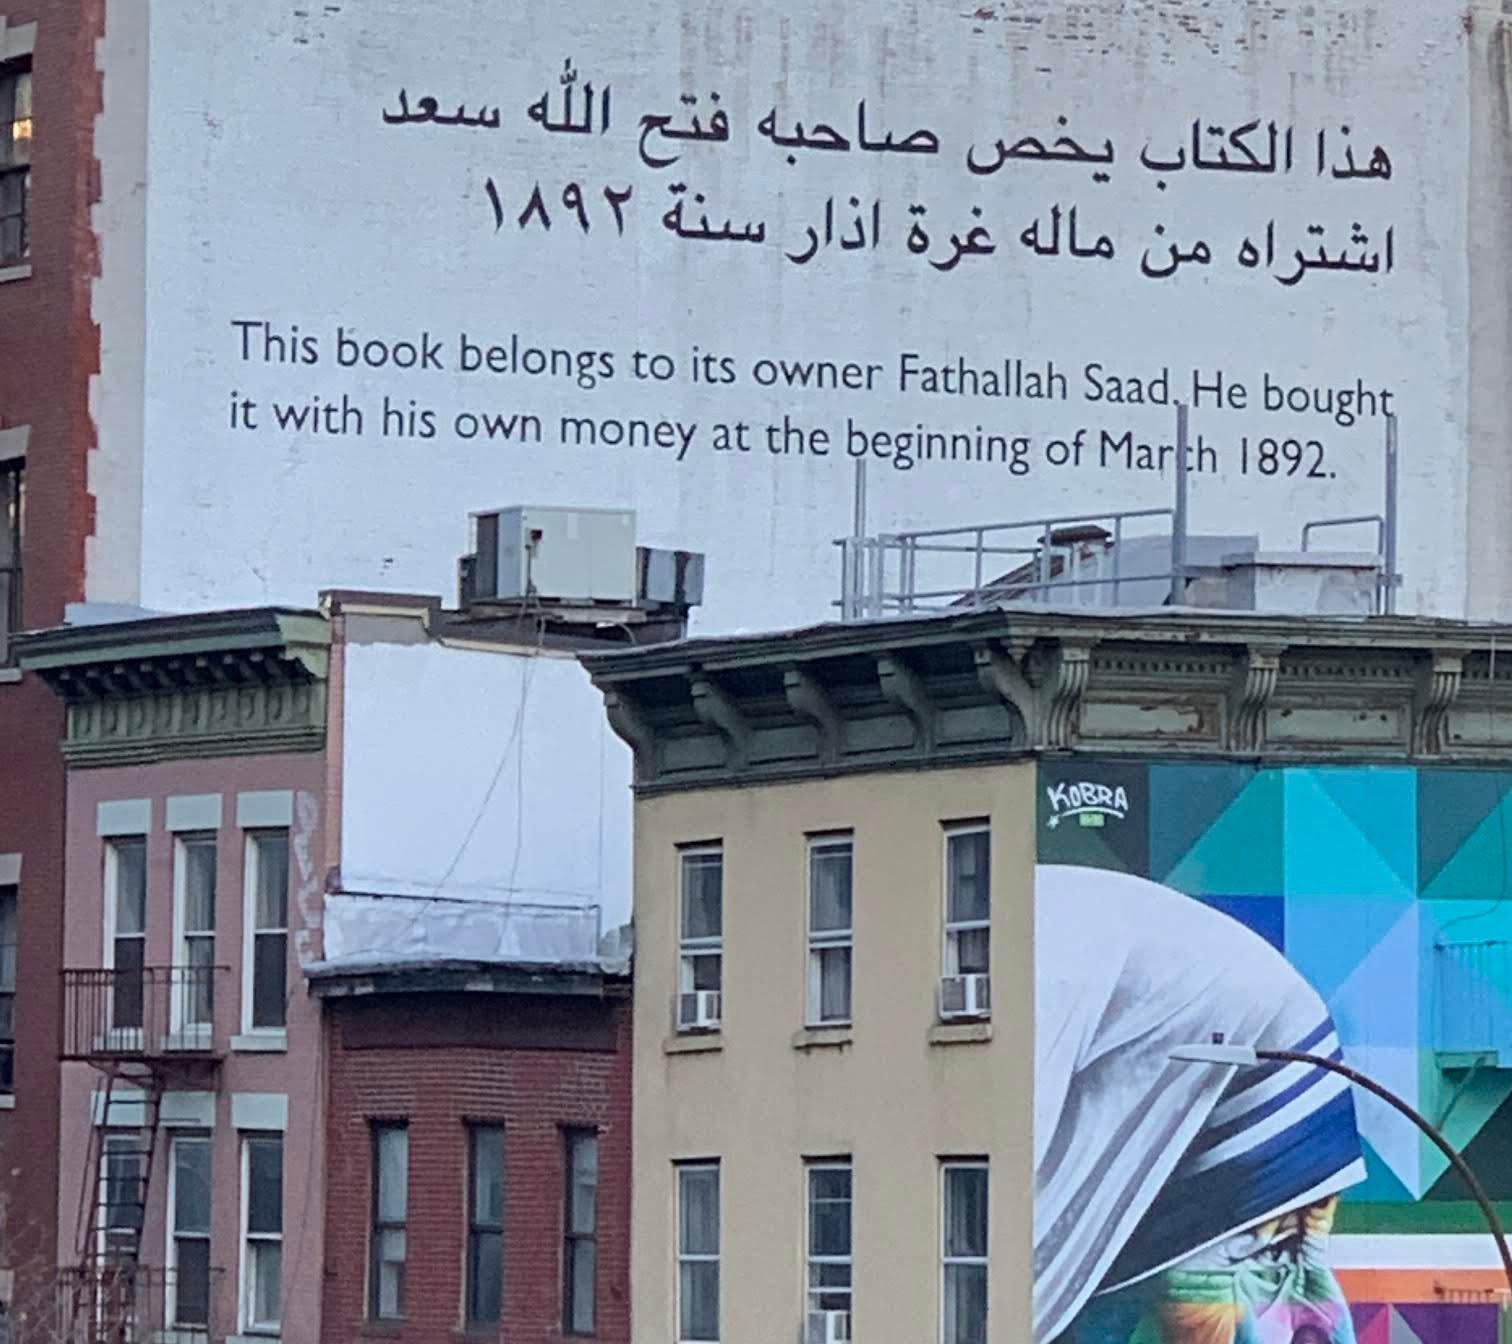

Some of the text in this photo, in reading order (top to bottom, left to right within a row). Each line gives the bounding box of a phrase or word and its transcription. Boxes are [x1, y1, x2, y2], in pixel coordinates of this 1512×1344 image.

[382, 87, 501, 129] سعد
[638, 91, 730, 169] فتح
[758, 98, 940, 166] صاحبه
[966, 115, 1115, 184] يخص
[1140, 118, 1293, 191] الكتاب
[1317, 124, 1391, 181] هذا
[661, 181, 766, 244] سنة
[784, 196, 882, 265] اذار
[906, 203, 997, 272] غرة
[1019, 203, 1115, 260] ماله
[1140, 223, 1212, 279] من
[1237, 219, 1394, 287] اشتراه
[230, 320, 319, 365] This
[336, 326, 444, 371] book
[460, 332, 615, 390] belongs
[631, 350, 675, 381] to
[692, 345, 736, 386] its
[752, 359, 884, 391] owner
[899, 352, 1068, 402] Fathallah
[1193, 369, 1248, 410] He
[1263, 372, 1394, 428] bought
[230, 390, 258, 431] it
[272, 393, 363, 437] with
[382, 395, 436, 439] his
[454, 412, 542, 443] own
[560, 416, 698, 463] money
[712, 421, 751, 453] at
[765, 414, 830, 456] the
[846, 417, 1032, 476] beginning
[1045, 428, 1088, 467] of
[1241, 437, 1337, 480] 1892.
[1046, 781, 1128, 811] KOBRA
